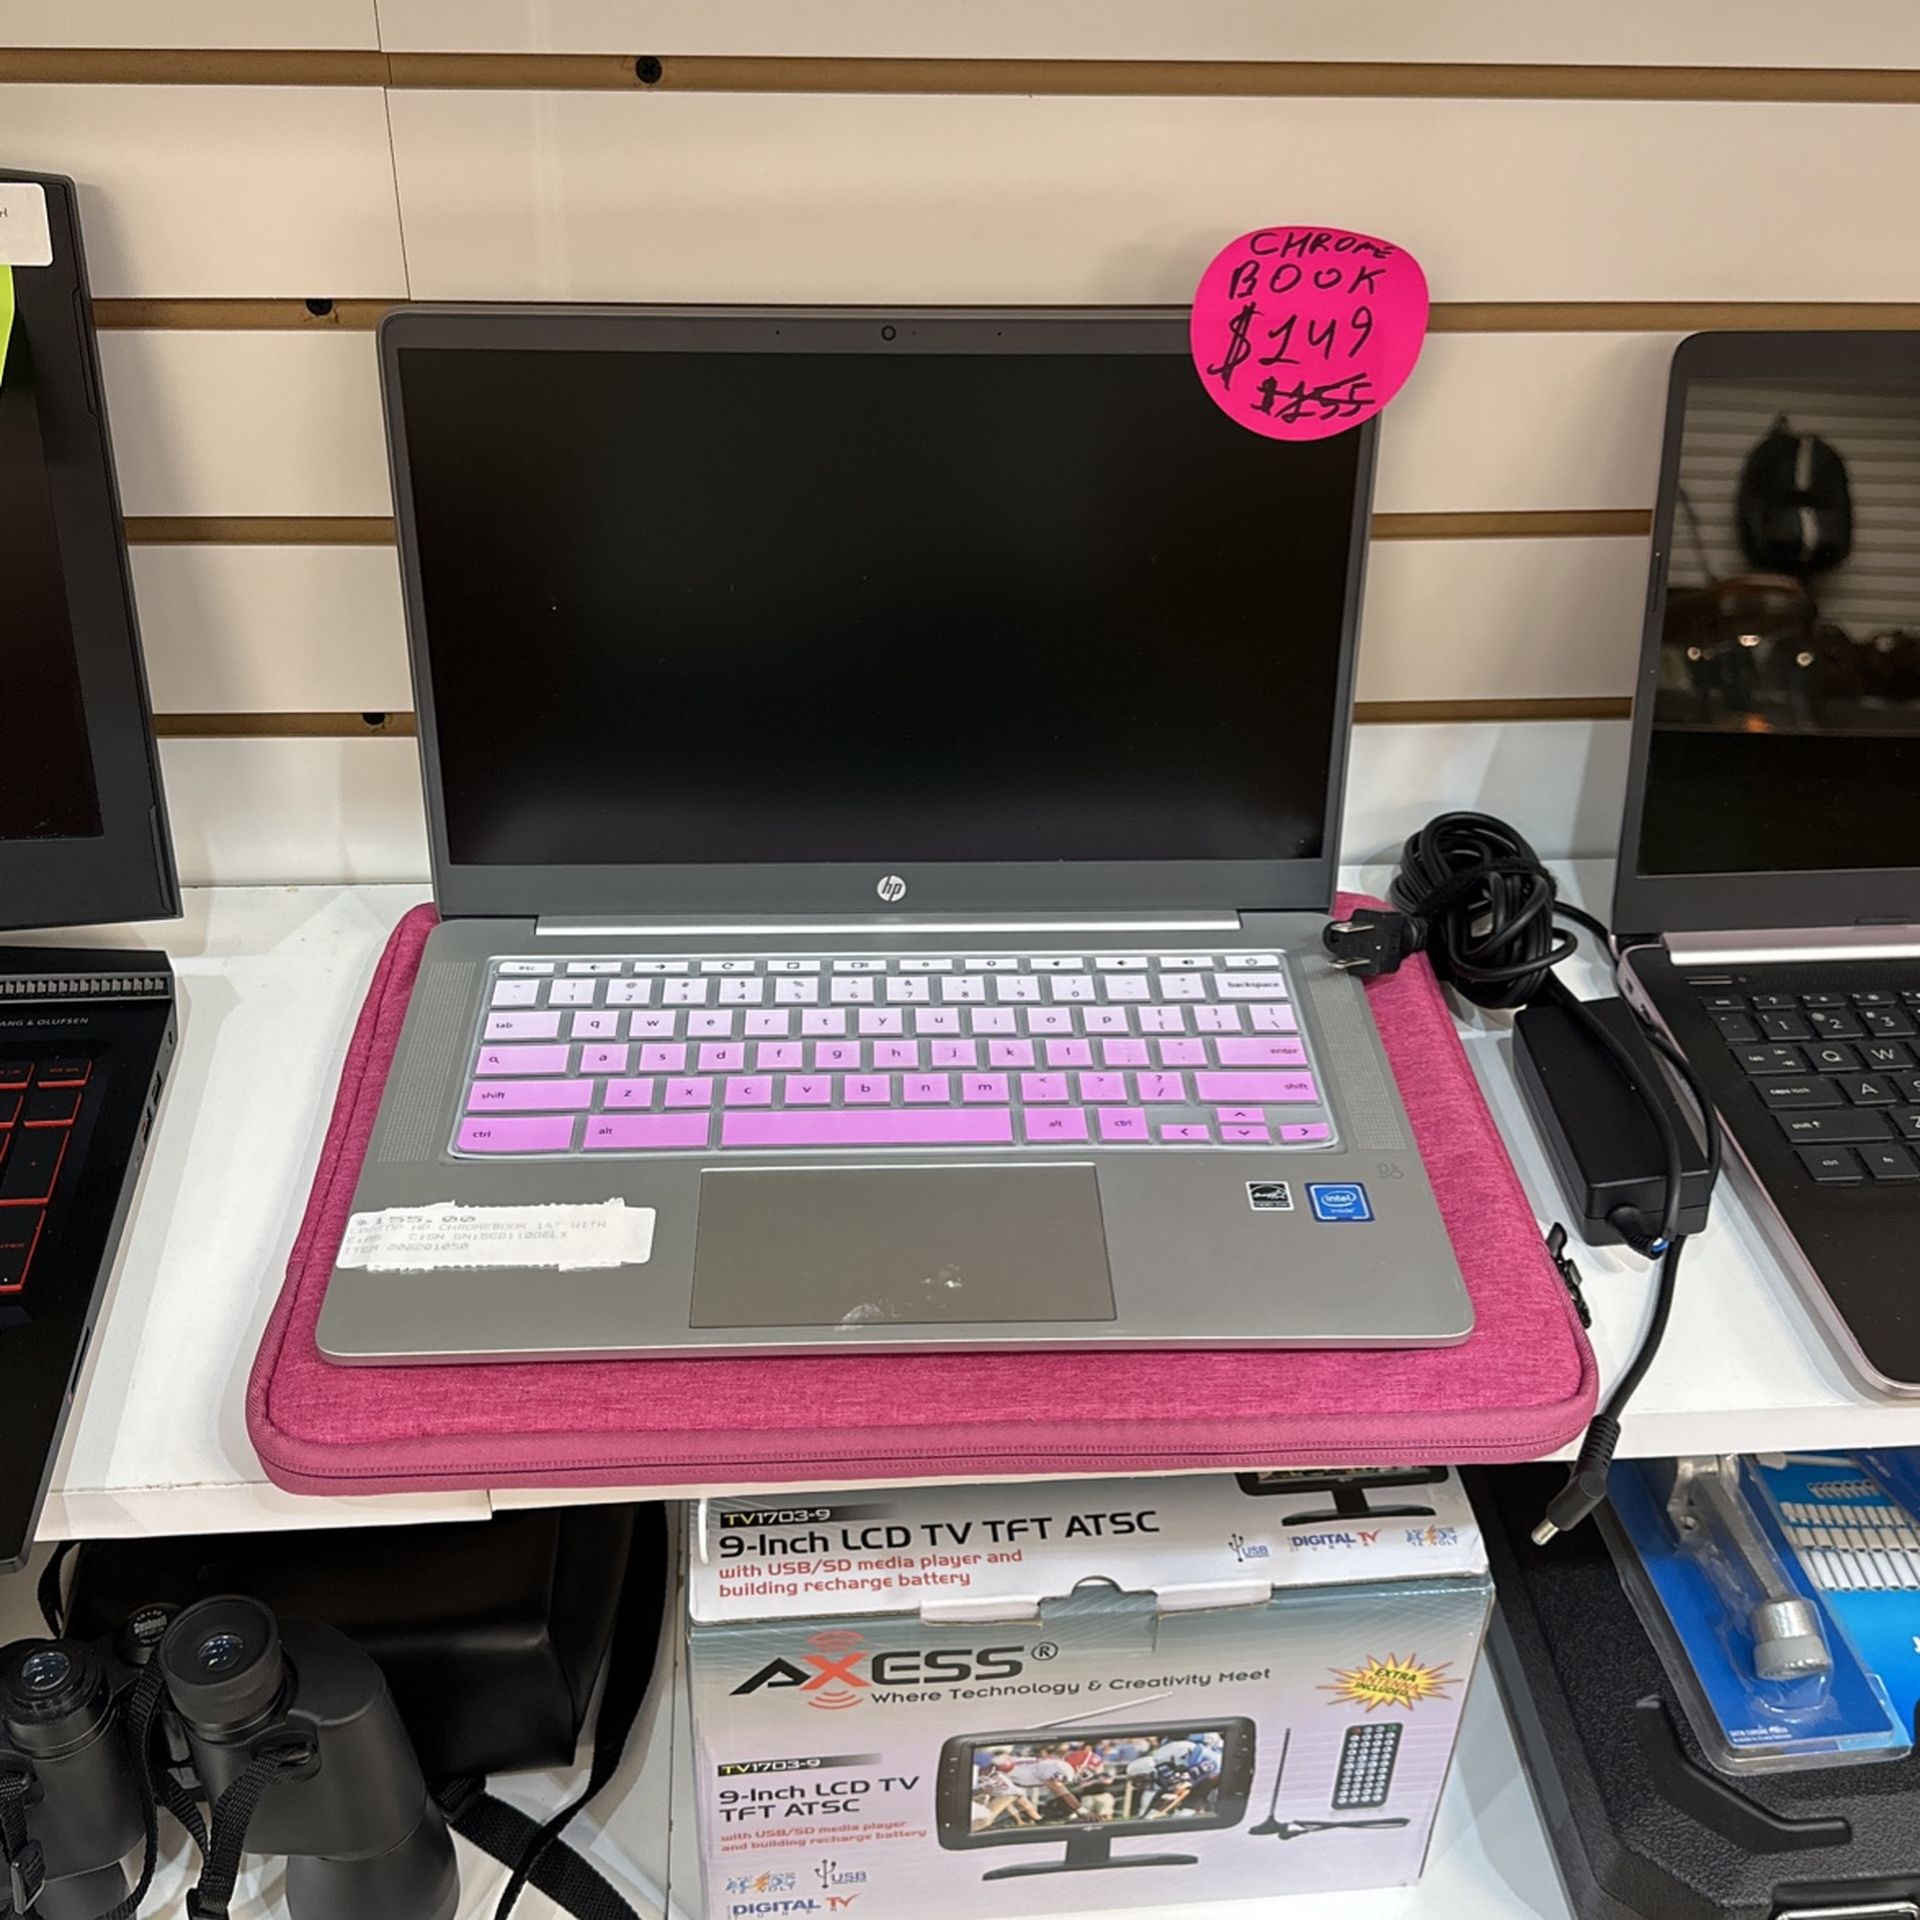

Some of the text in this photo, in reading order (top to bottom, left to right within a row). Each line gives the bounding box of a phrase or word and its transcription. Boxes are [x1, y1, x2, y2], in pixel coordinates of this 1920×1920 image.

[1250, 231, 1395, 259] CHROME
[1228, 260, 1387, 300] BOOK
[1206, 301, 1373, 391] $149
[879, 875, 906, 902] hp
[1227, 980, 1282, 989] backspace
[36, 1017, 89, 1026] OLUFSEN
[1829, 1018, 1844, 1029] 2
[1880, 1016, 1895, 1028] 3
[1821, 1049, 1842, 1062] Q
[1870, 1048, 1894, 1060] W
[481, 1091, 506, 1100] shift
[1284, 1082, 1309, 1090] shift
[1861, 1082, 1879, 1095] A
[472, 1130, 492, 1138] ctrl
[1324, 1192, 1354, 1203] intel
[438, 1221, 528, 1232] CHROMEBOOK
[723, 1508, 831, 1528] TV1703-9
[719, 1510, 1160, 1559] 9-Inch LCD TV TFT ATSC
[1292, 1532, 1356, 1548] DIGITAL
[1357, 1529, 1382, 1544] TV
[1242, 1544, 1269, 1557] USB
[719, 1549, 1023, 1580] with USB/SD media player and
[719, 1571, 971, 1599] building recharge battery
[729, 1645, 1025, 1697] AXESS
[1375, 1668, 1417, 1682] EXTRA
[872, 1668, 1271, 1704] Where Technology & Creativity Meet
[1355, 1673, 1420, 1692] ANTENNA
[721, 1758, 821, 1775] TV1703-9
[719, 1776, 920, 1805] 9-Inch LCD TV
[719, 1799, 861, 1823] TFT ATSC
[720, 1820, 908, 1842] with USB/SD media player
[721, 1828, 928, 1852] and building recharge battery
[831, 1870, 868, 1884] USB
[732, 1892, 862, 1916] DIGITAL TV
